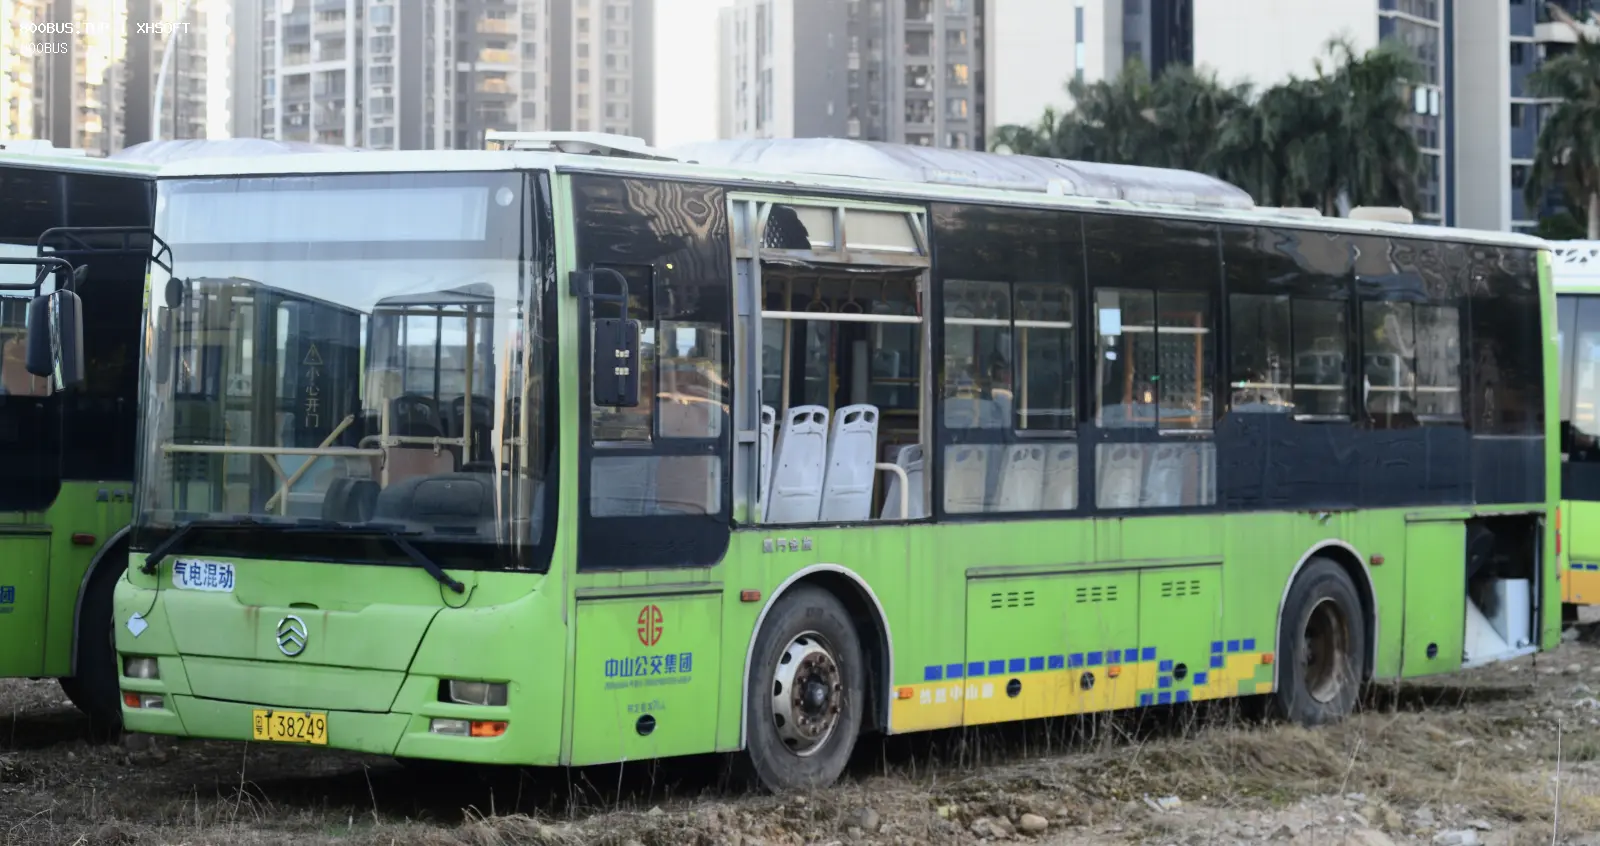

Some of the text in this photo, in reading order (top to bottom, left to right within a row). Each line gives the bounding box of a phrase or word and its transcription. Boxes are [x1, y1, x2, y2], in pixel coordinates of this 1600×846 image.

[304, 366, 320, 428] 小心开门
[173, 560, 233, 588] 气电混动
[604, 652, 693, 679] 中山公交集团
